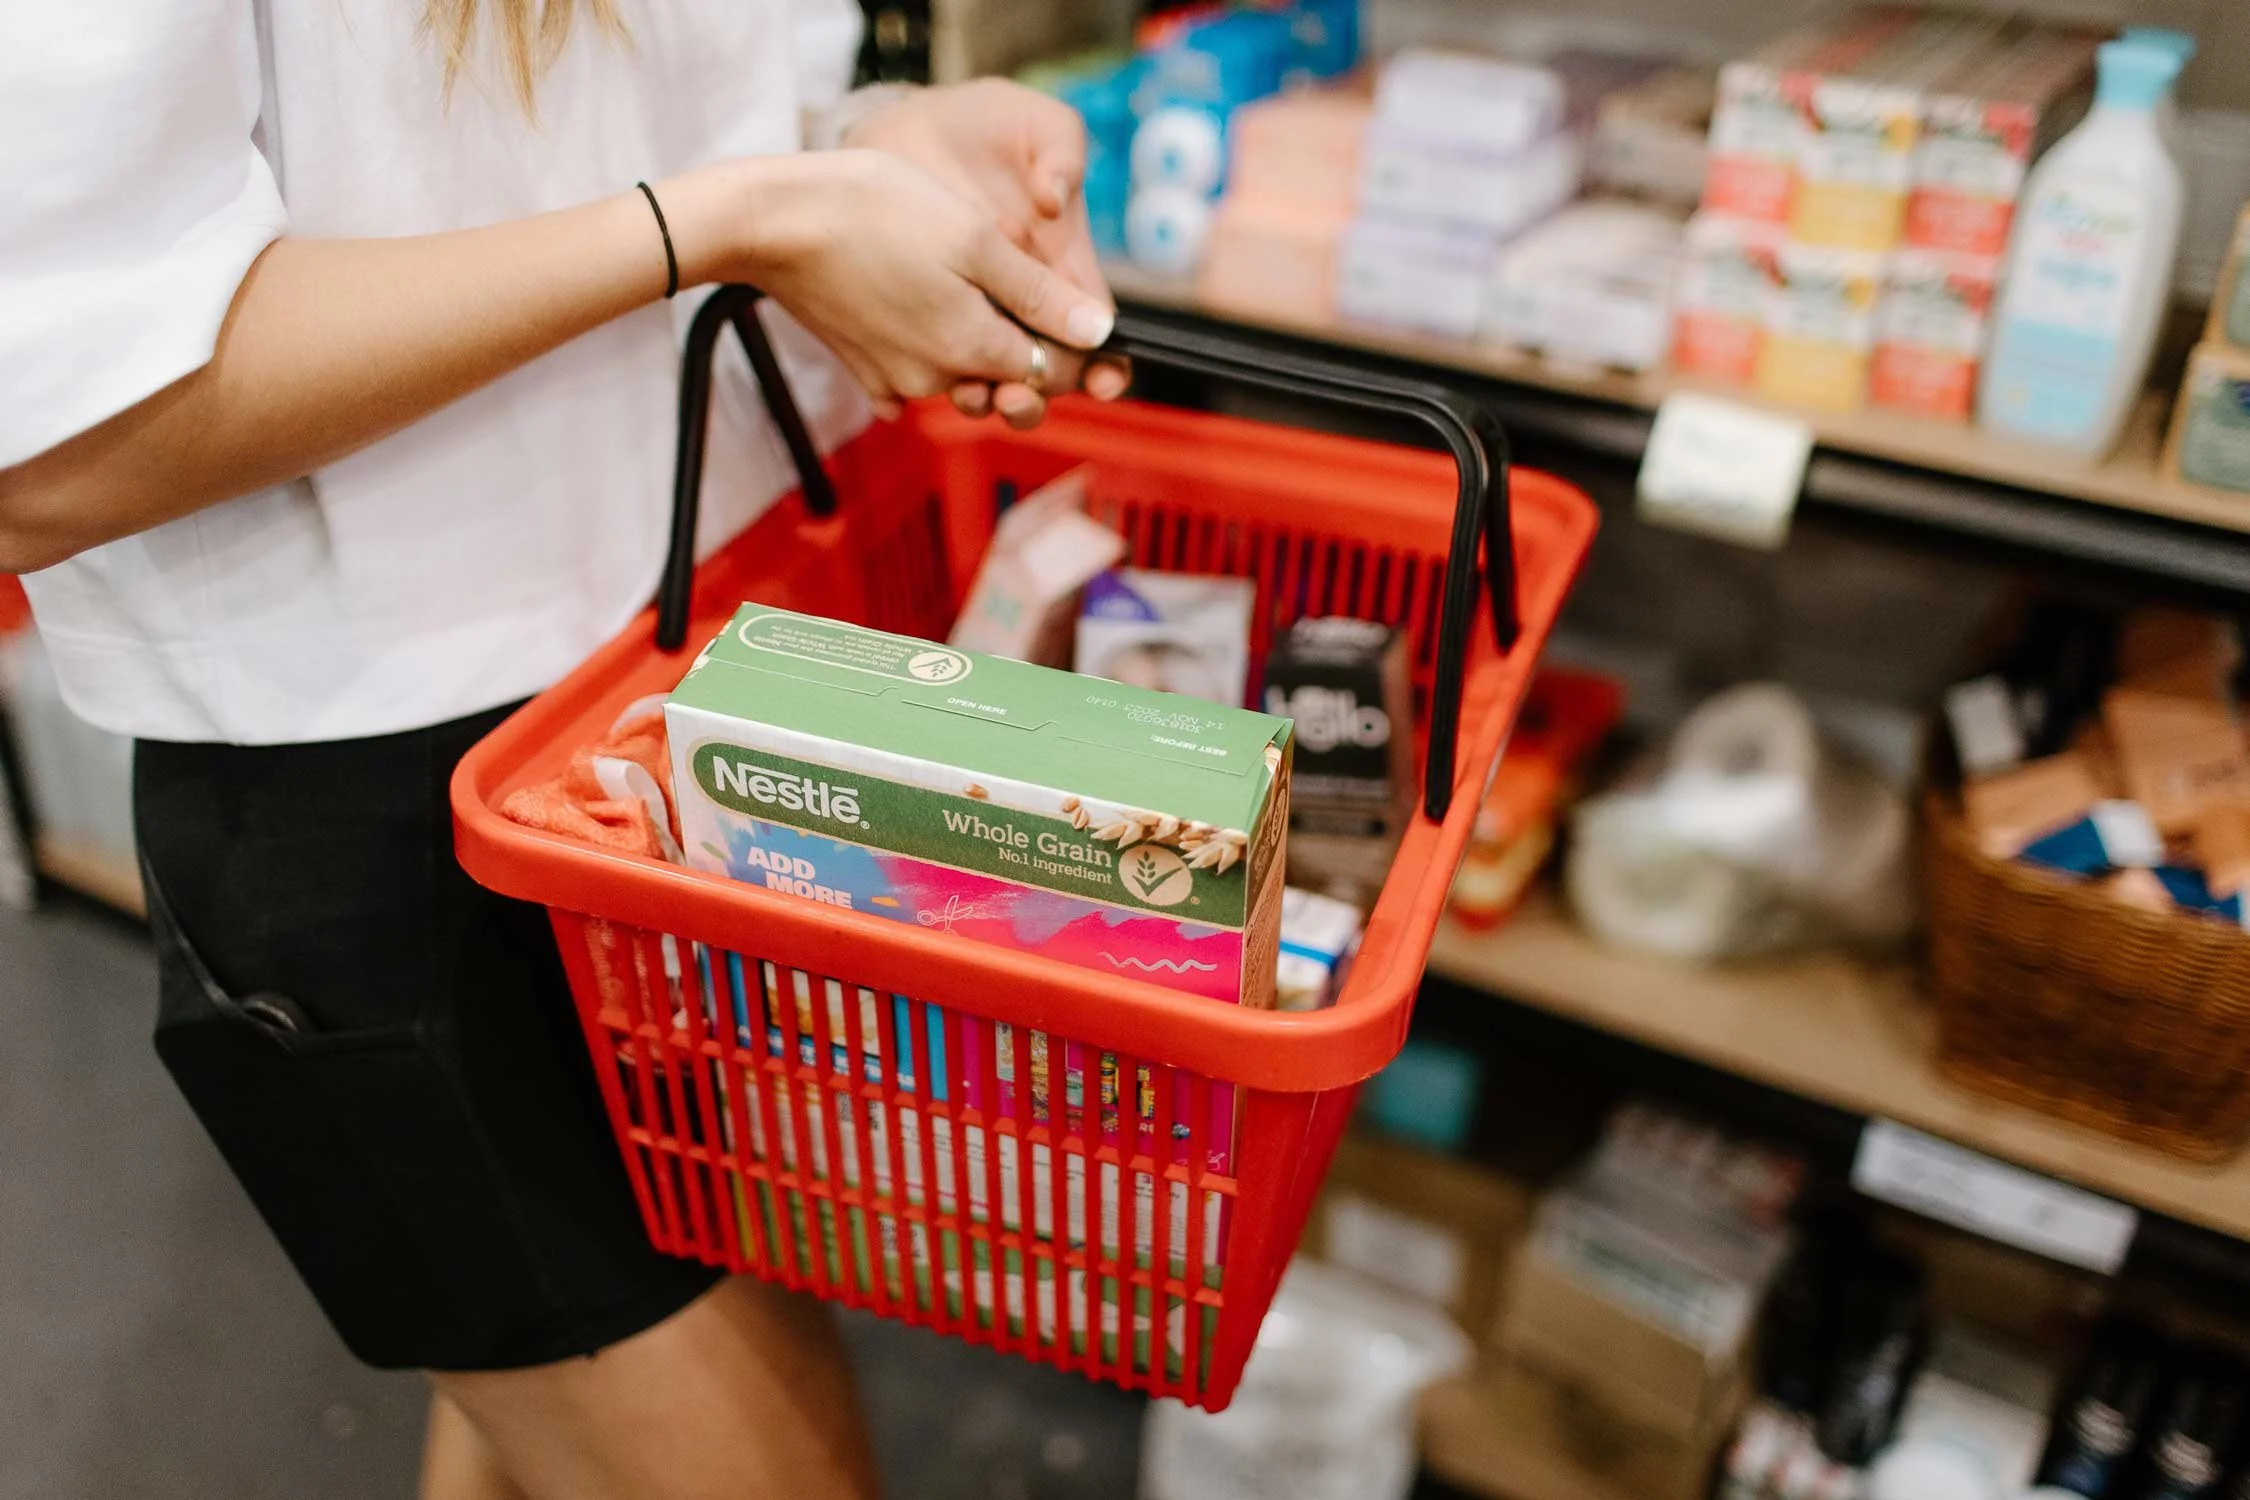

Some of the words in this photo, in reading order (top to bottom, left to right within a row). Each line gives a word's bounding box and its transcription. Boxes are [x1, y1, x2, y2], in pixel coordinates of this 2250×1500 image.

[947, 697, 977, 709] OPEN
[978, 704, 1008, 716] HERE
[1168, 712, 1200, 726] NOV
[1197, 745, 1228, 757] BEST
[942, 808, 1031, 849] Whole
[1036, 831, 1113, 869] Grain
[747, 846, 816, 880] ADD
[998, 846, 1030, 867] No.1
[1032, 854, 1114, 885] ingredient
[764, 870, 853, 909] MORE
